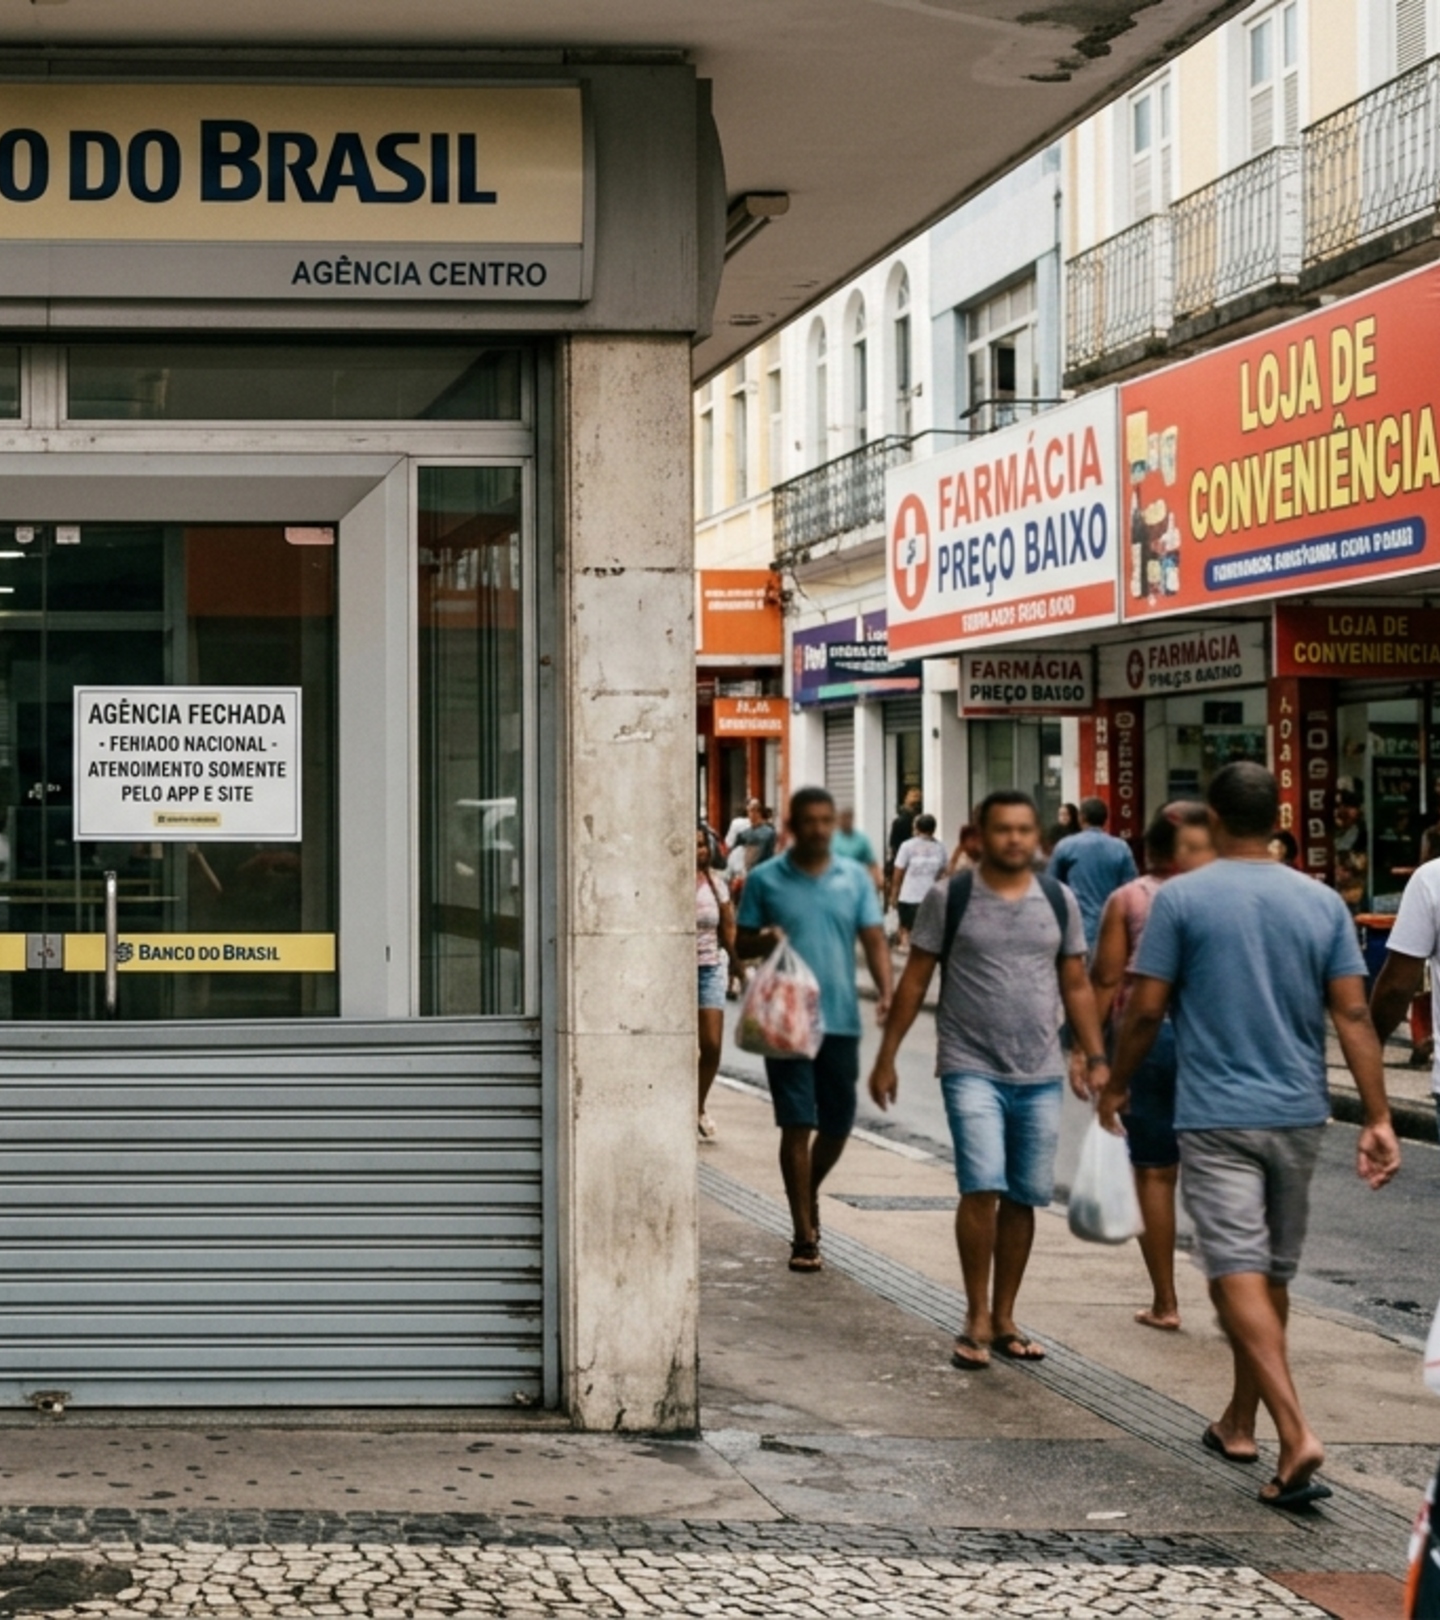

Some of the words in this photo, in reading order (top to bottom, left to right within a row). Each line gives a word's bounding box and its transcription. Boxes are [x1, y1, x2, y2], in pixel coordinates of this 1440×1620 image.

[69, 128, 181, 201] DO
[200, 119, 497, 204] BRASIL
[291, 255, 421, 285] AGÊNCIA
[429, 261, 547, 286] CENTRO
[1239, 337, 1323, 434] LOJA
[1330, 314, 1378, 406] DE
[938, 425, 1103, 532] FARMÁCIA
[1189, 404, 1440, 542] CONVENIÊNCIA
[937, 526, 1015, 597] PREÇO
[1024, 502, 1107, 575] BAIXO
[1383, 615, 1408, 636] DE
[1149, 631, 1240, 669] FARMÁCIA
[970, 655, 1083, 680] FARMÁCIA
[88, 698, 181, 724] AGÊNCIA
[188, 703, 286, 724] FECHADA
[184, 736, 267, 752] NACIONAL
[208, 761, 286, 777] SOMENTE
[121, 785, 162, 802] PELO
[166, 785, 199, 802] APP
[204, 786, 213, 802] E
[218, 785, 254, 802] SITE
